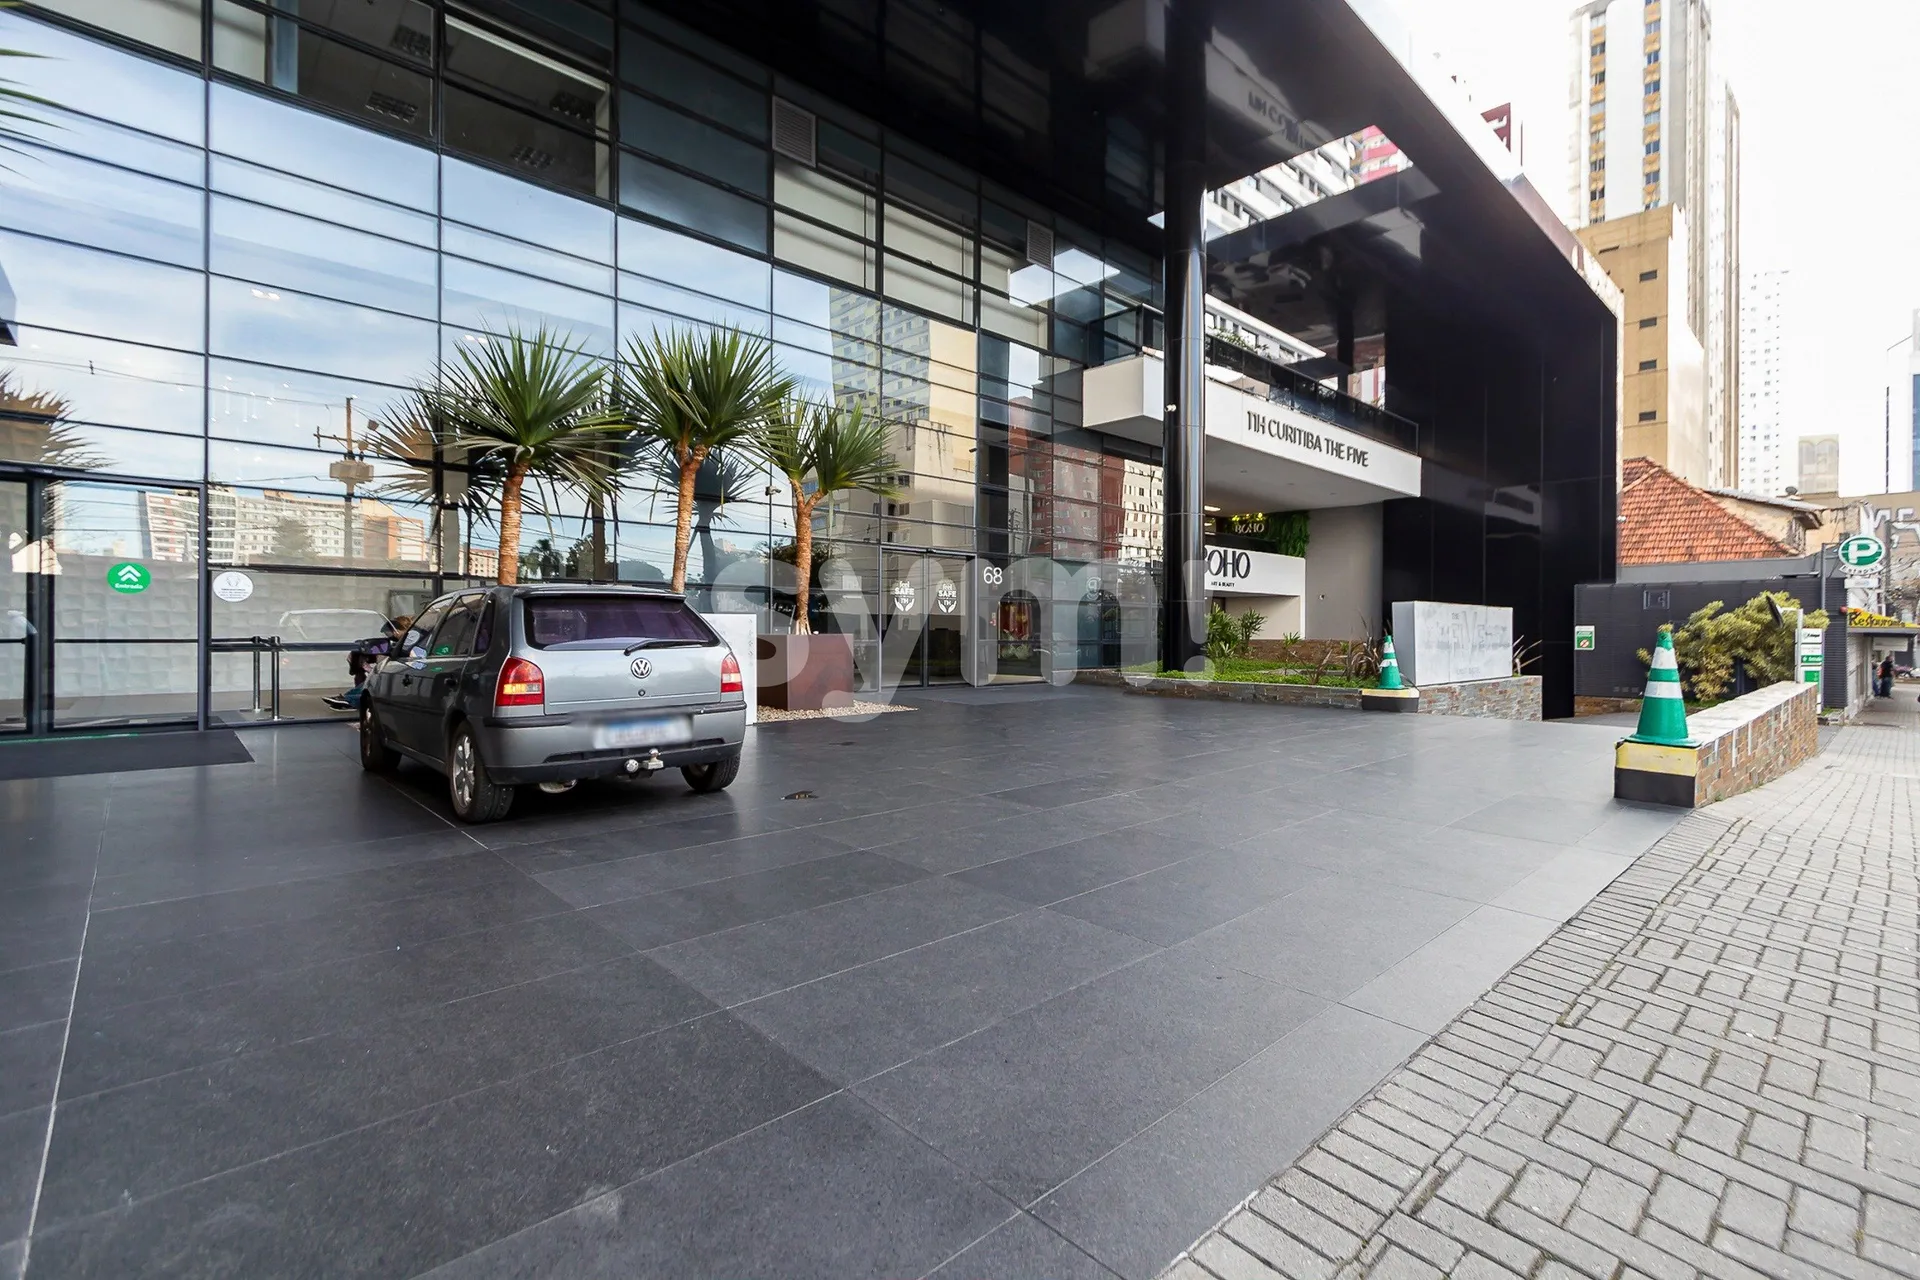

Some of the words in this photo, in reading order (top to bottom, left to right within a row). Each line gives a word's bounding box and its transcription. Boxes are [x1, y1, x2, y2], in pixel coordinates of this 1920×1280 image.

[1268, 418, 1322, 452] CURITIBA
[1324, 437, 1345, 460] THE
[1346, 445, 1369, 468] FIVE
[1234, 522, 1265, 534] BOHO
[1848, 540, 1879, 564] P
[983, 566, 1003, 585] 68
[894, 587, 915, 596] SAFE
[938, 590, 957, 598] SAFE
